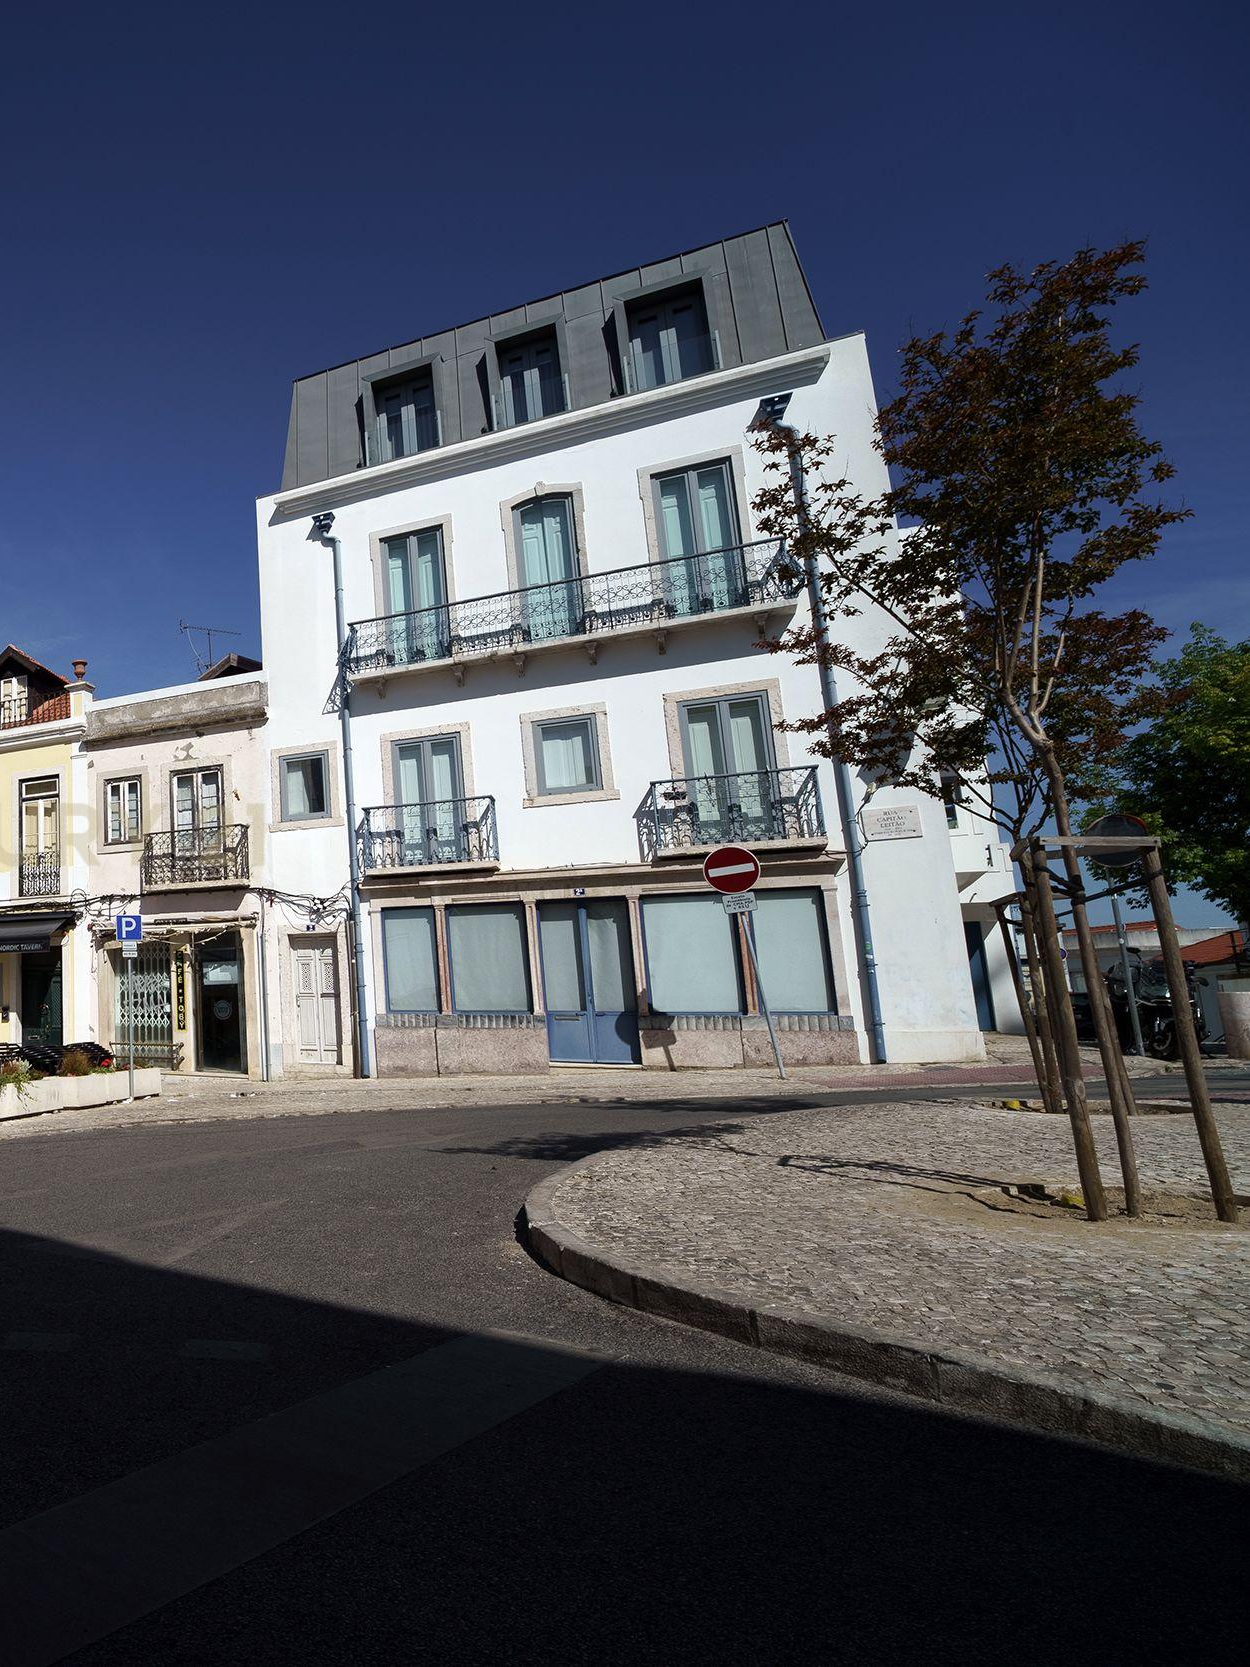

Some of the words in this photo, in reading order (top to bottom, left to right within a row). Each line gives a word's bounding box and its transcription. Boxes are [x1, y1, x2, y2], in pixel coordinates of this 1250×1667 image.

[877, 815, 907, 823] CAPITÃO
[122, 917, 136, 938] P
[176, 951, 184, 984] CAFÉ
[178, 996, 186, 1029] TOBY
